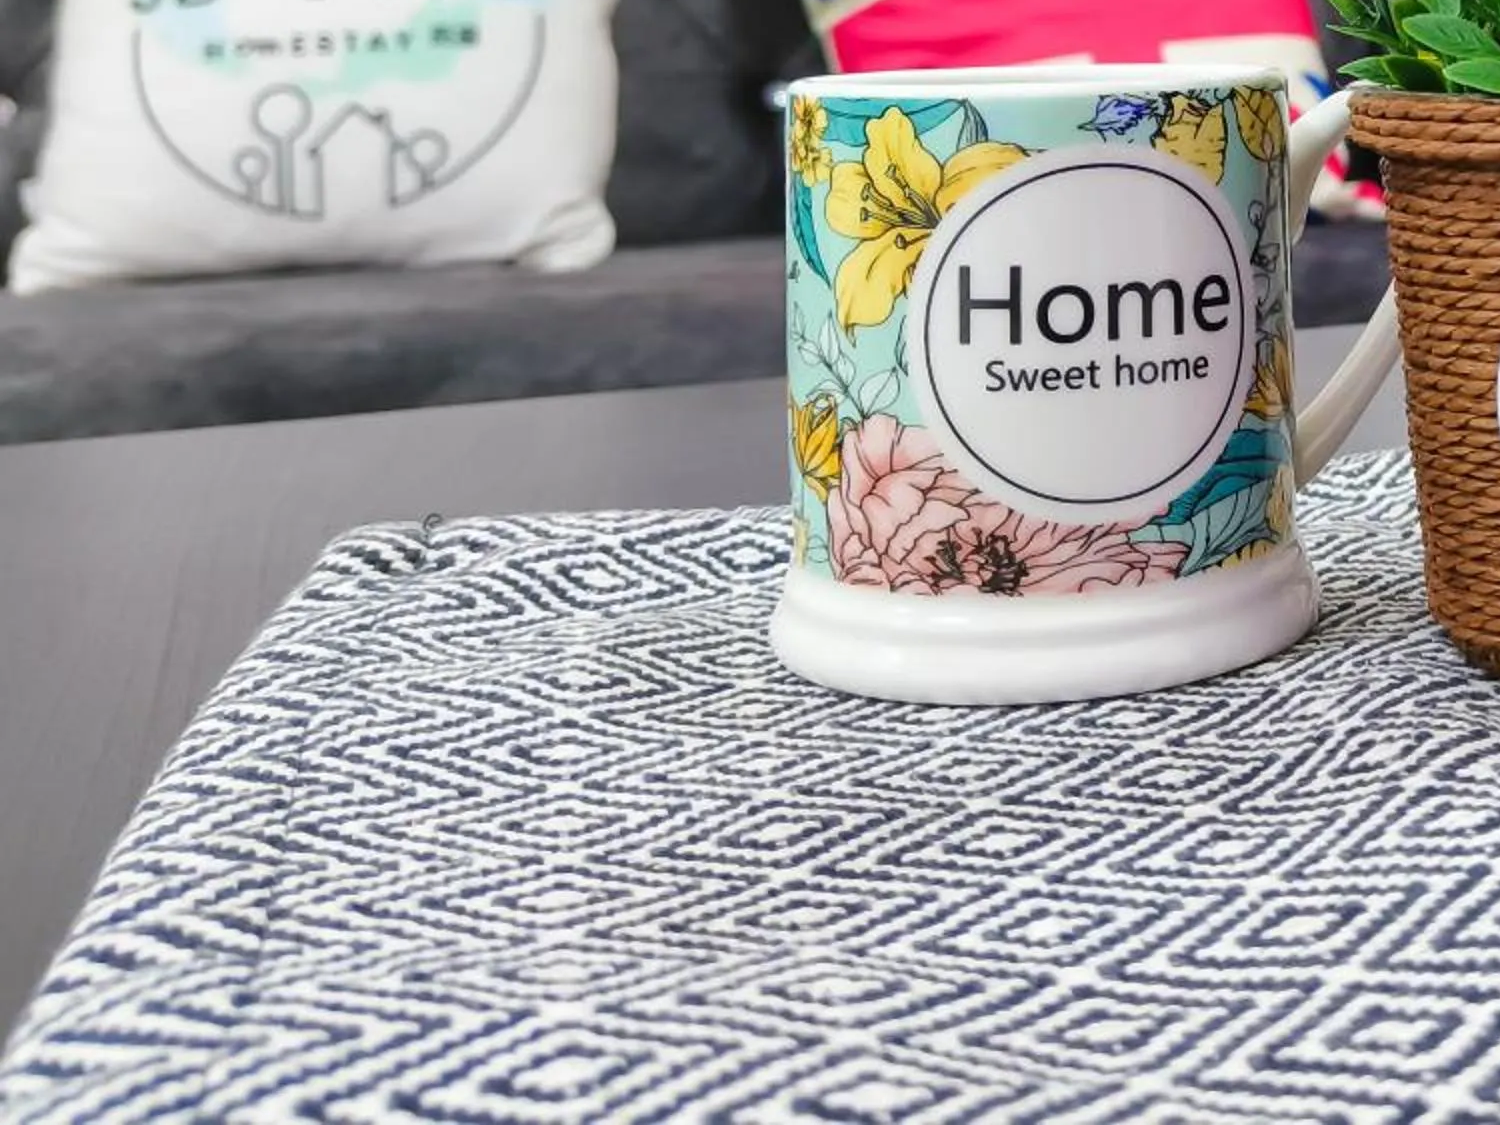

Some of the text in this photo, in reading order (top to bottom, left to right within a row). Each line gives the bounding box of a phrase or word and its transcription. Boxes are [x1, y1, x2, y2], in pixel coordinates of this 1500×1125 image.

[959, 265, 1231, 345] Home
[985, 355, 1209, 392] Sweet home
